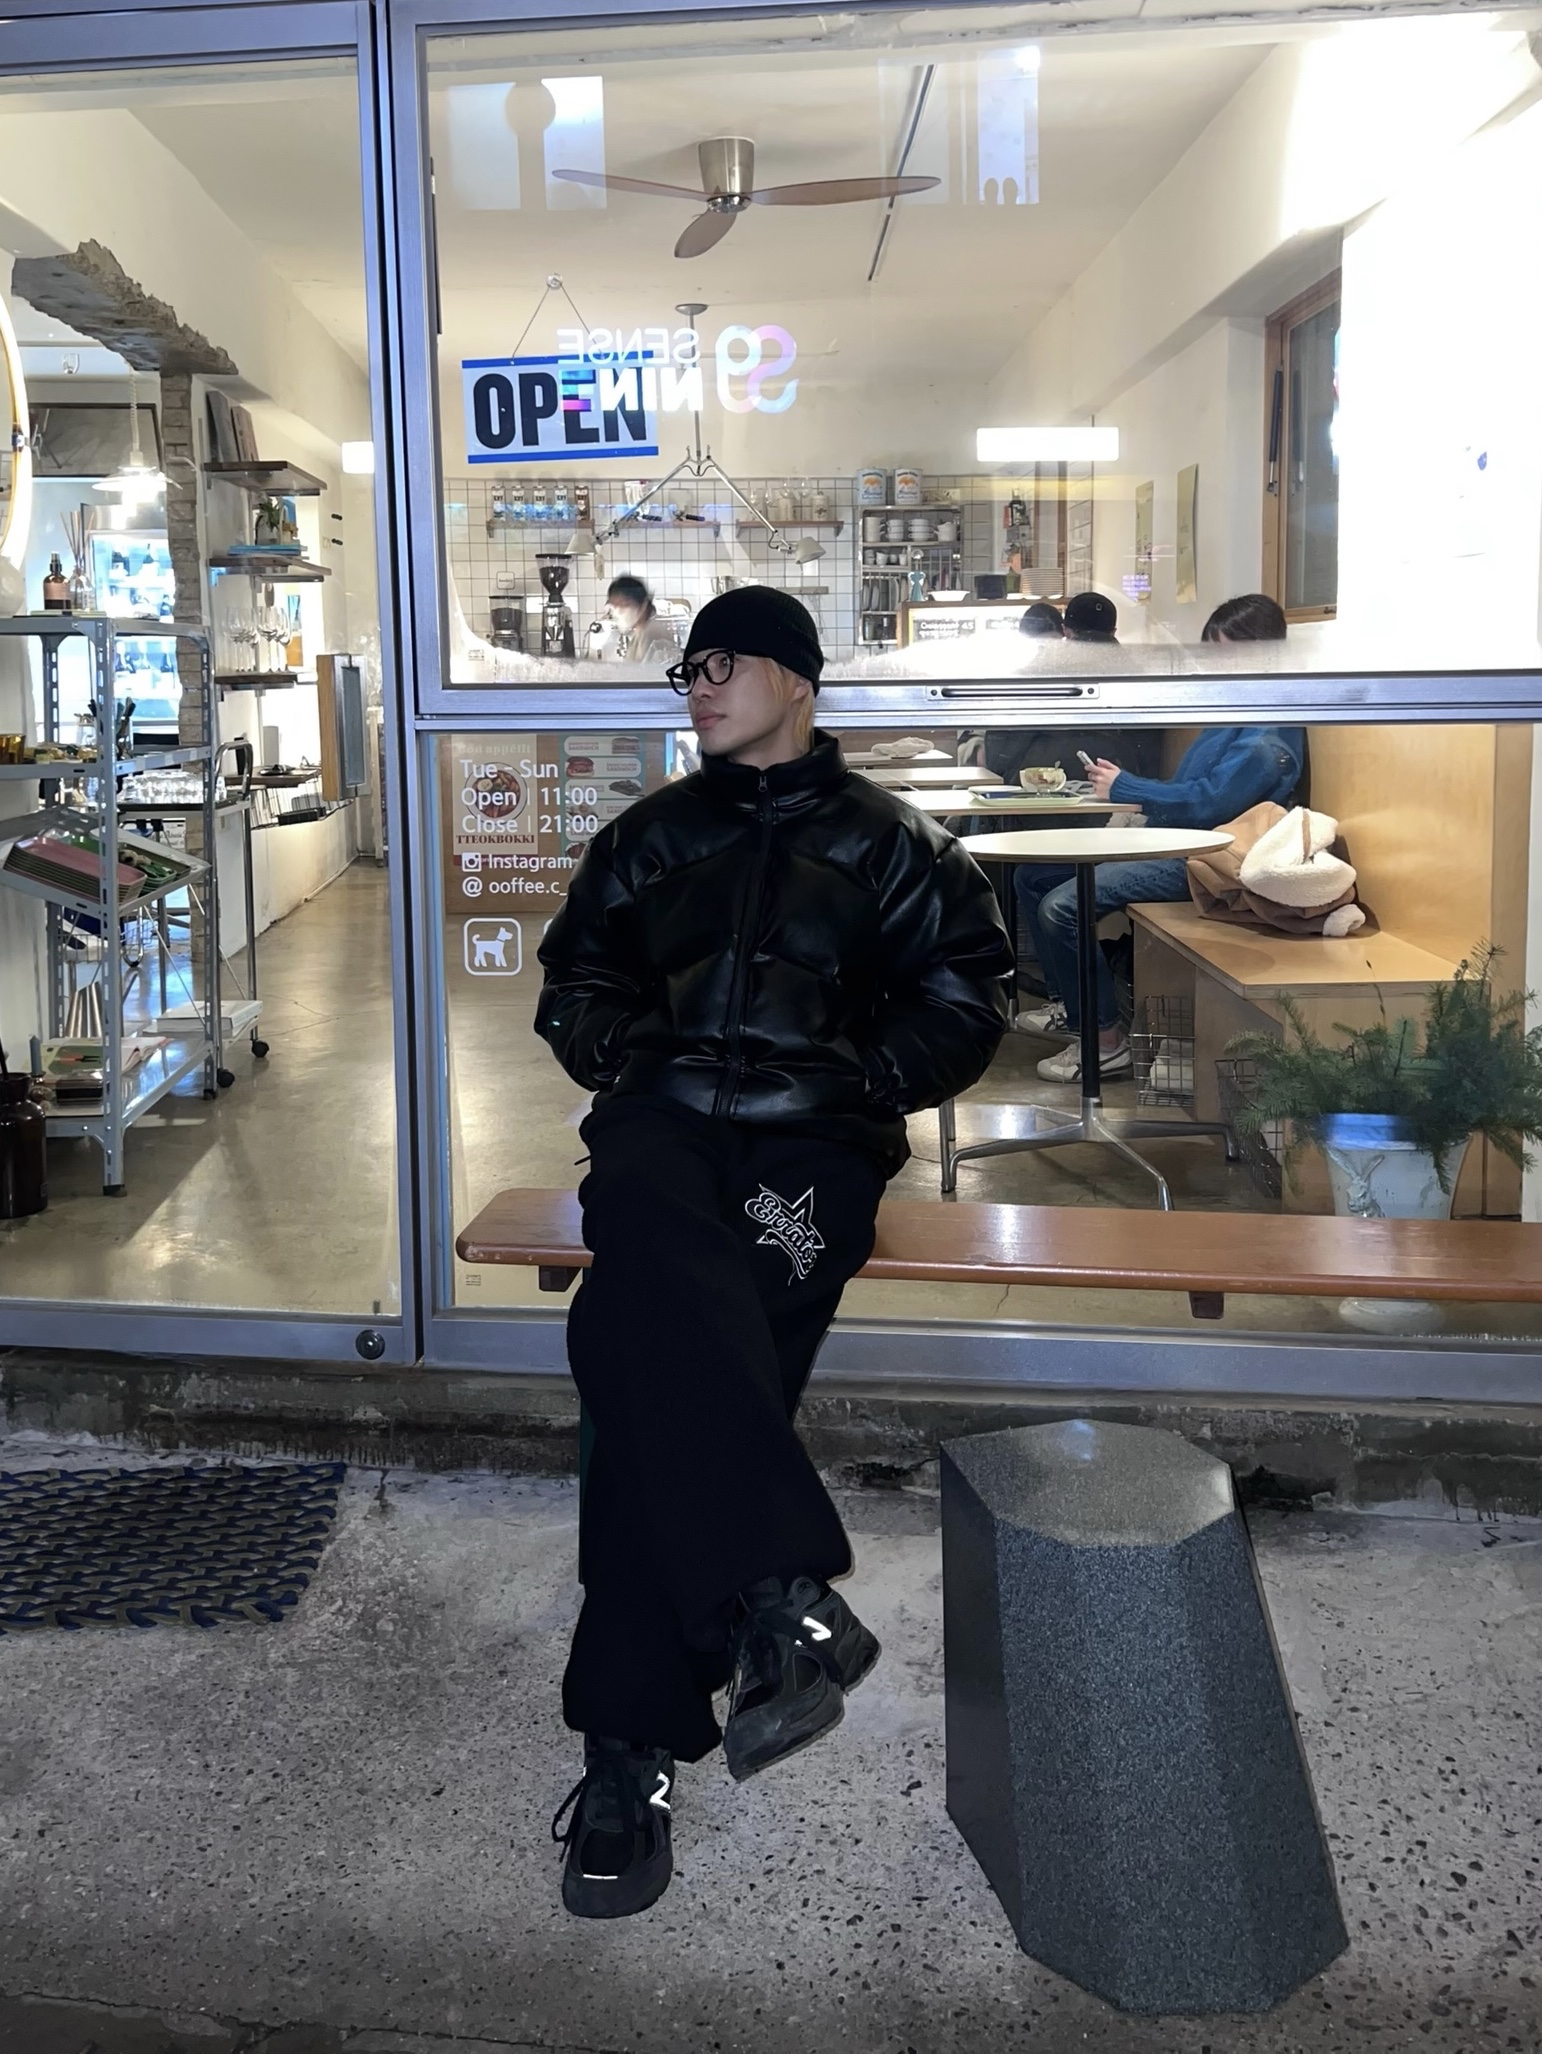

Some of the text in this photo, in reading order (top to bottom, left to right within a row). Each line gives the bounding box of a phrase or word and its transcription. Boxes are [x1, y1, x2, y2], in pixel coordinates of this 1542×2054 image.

[473, 366, 647, 450] OPEN
[459, 759, 498, 779] Tue
[520, 759, 559, 779] Sun
[461, 787, 517, 810] Open
[541, 787, 598, 806] 11:00
[461, 815, 518, 834] Close
[539, 815, 599, 834] 21:00
[456, 834, 535, 845] TTEOKBOKKI
[488, 853, 573, 872] Instagram
